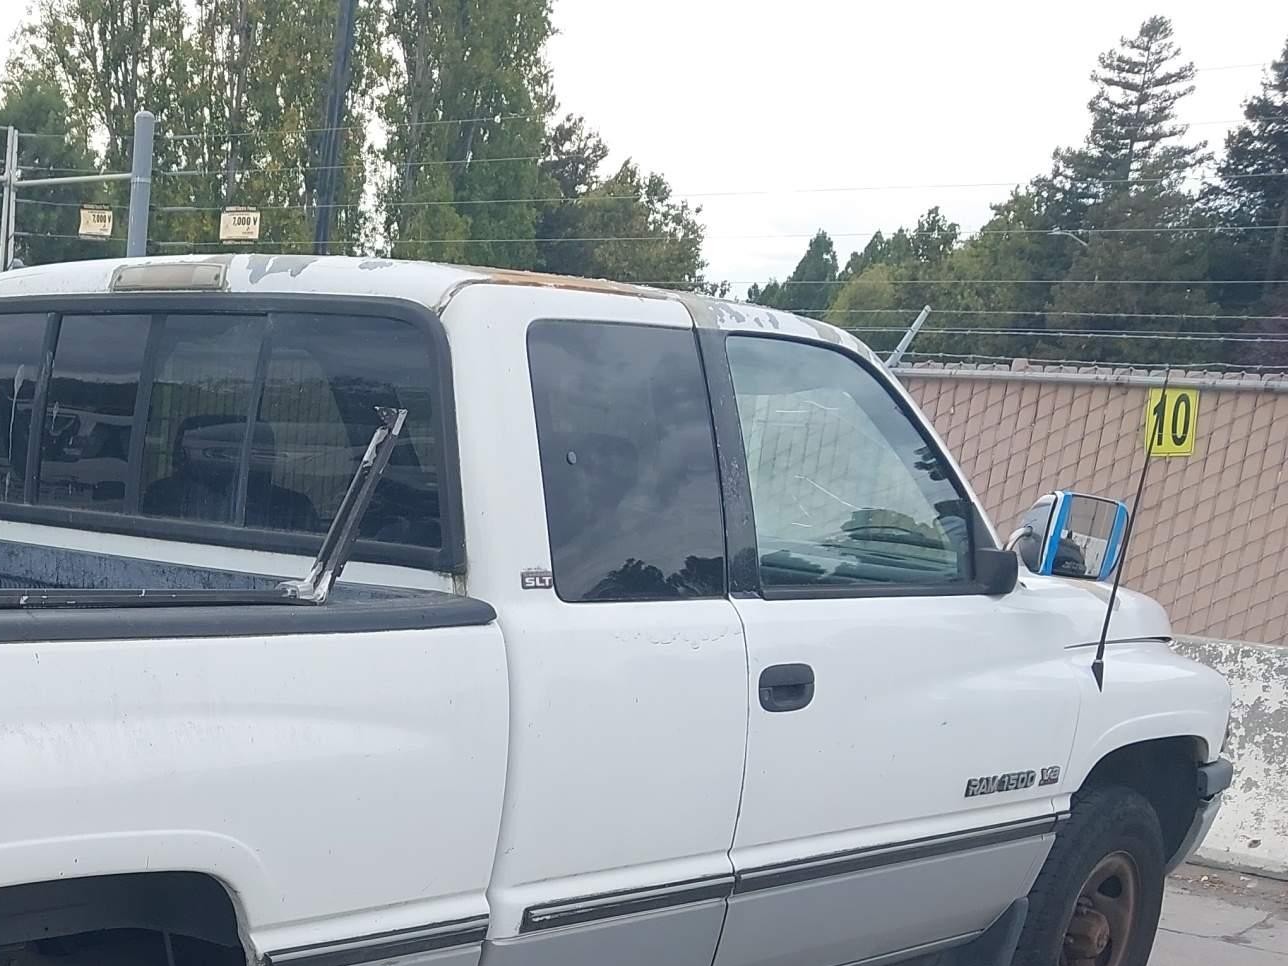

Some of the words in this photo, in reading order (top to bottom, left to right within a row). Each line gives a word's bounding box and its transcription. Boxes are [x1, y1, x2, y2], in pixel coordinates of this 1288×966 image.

[232, 216, 251, 226] 7,000
[1153, 393, 1191, 446] 10
[524, 576, 552, 587] SLT
[965, 778, 998, 797] RAM
[997, 770, 1036, 793] 1500
